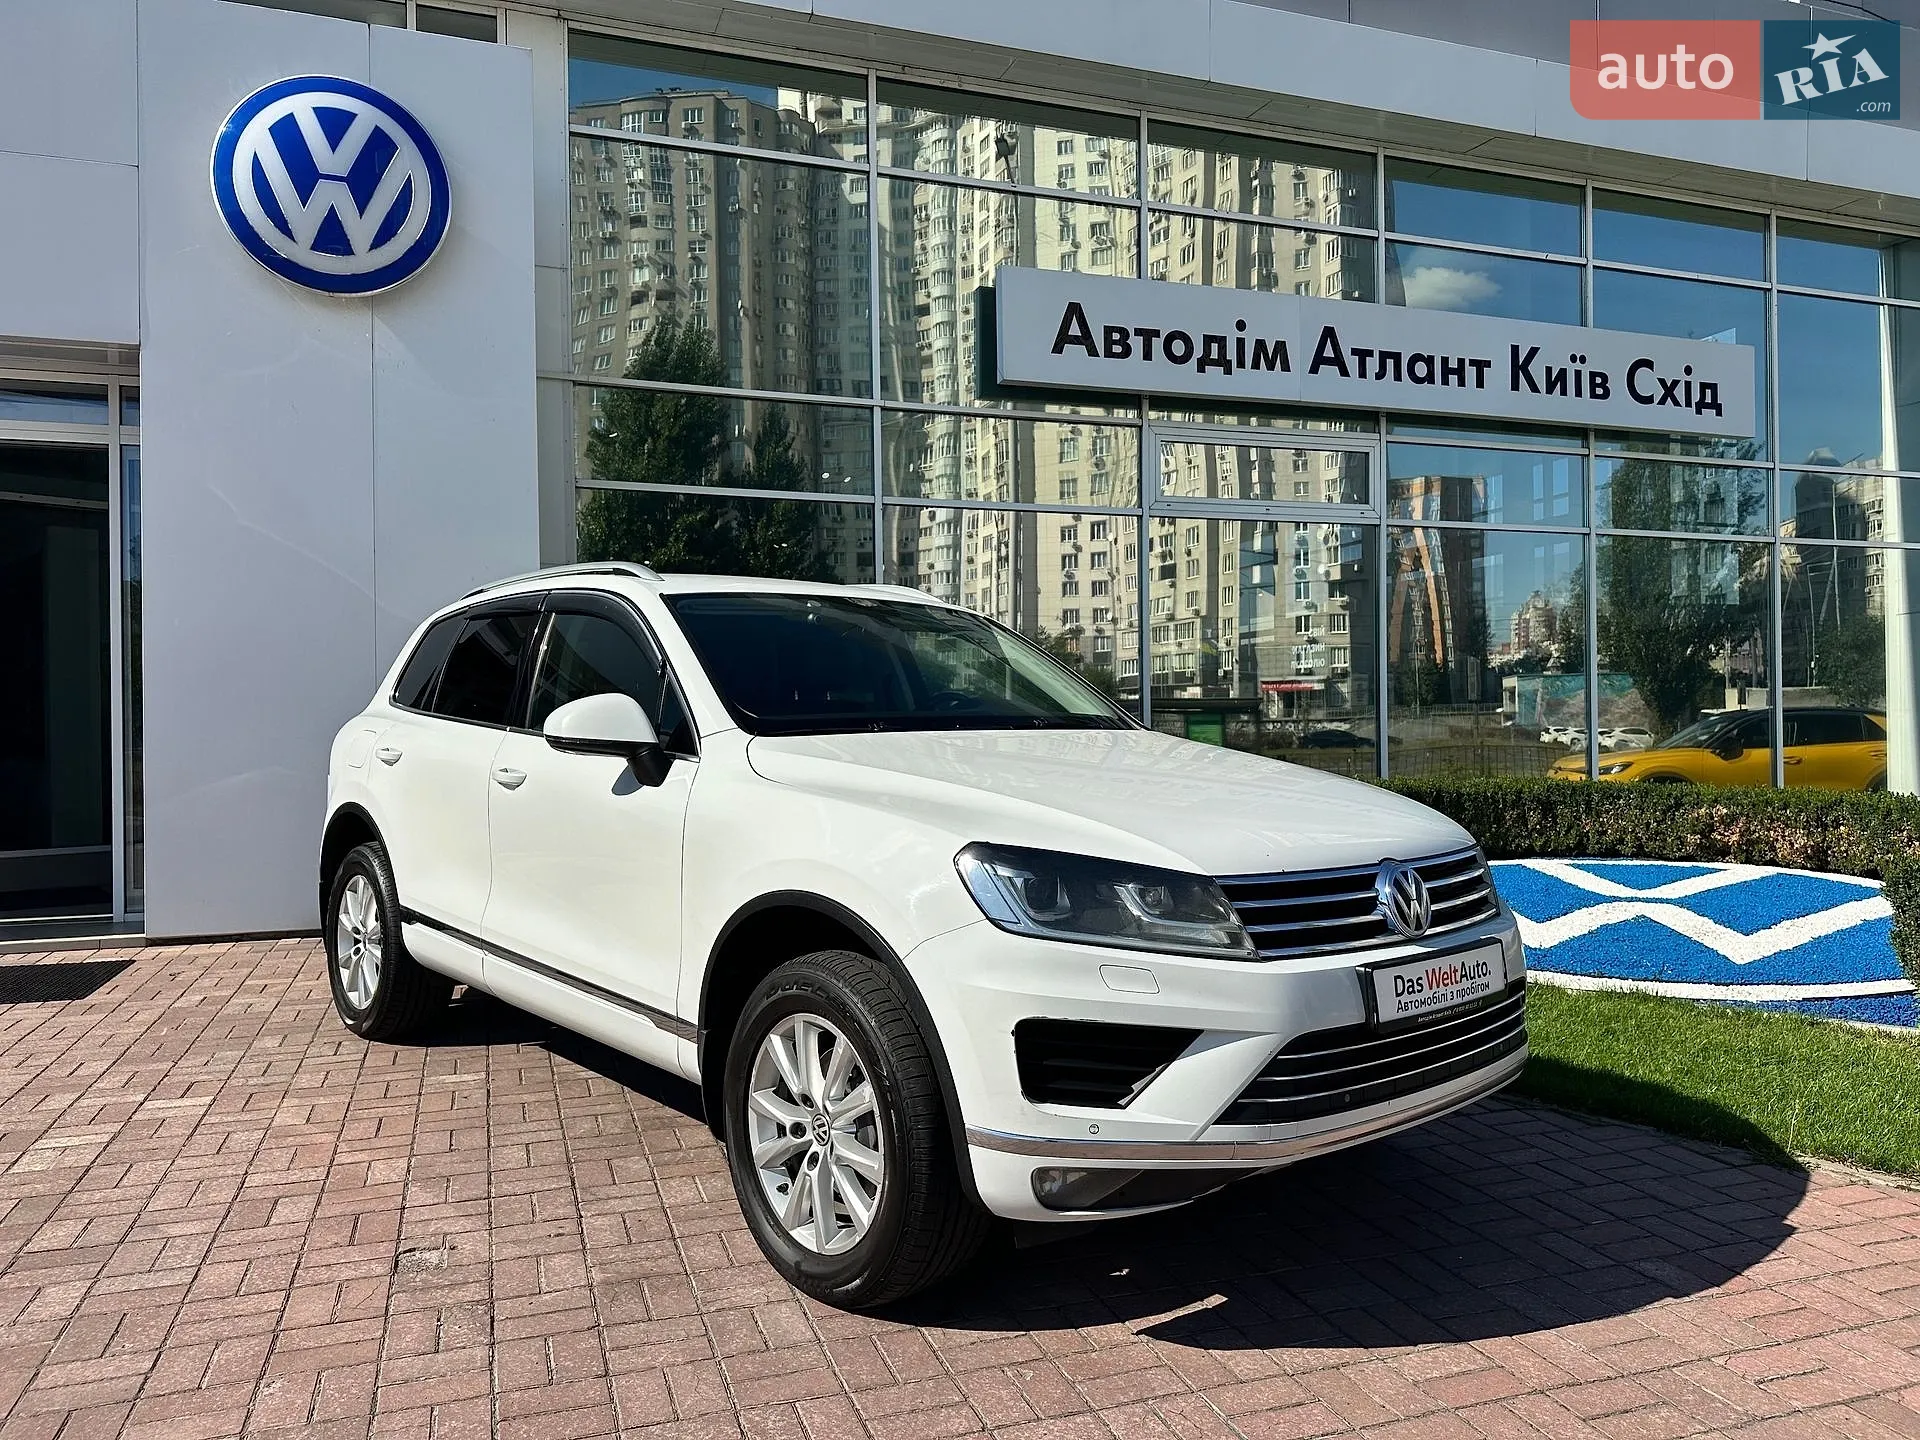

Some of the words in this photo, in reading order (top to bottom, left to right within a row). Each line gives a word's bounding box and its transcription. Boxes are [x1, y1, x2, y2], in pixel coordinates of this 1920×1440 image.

[1051, 301, 1291, 376] Автодім
[1308, 325, 1492, 389] Атлант
[1510, 344, 1612, 401] Київ
[1626, 358, 1723, 417] Схід
[1393, 975, 1424, 998] Das
[1425, 960, 1492, 991] WeltAuto.
[1396, 988, 1449, 1013] Автомобілі
[1450, 990, 1455, 1001] з
[1456, 981, 1490, 1001] пробігом
